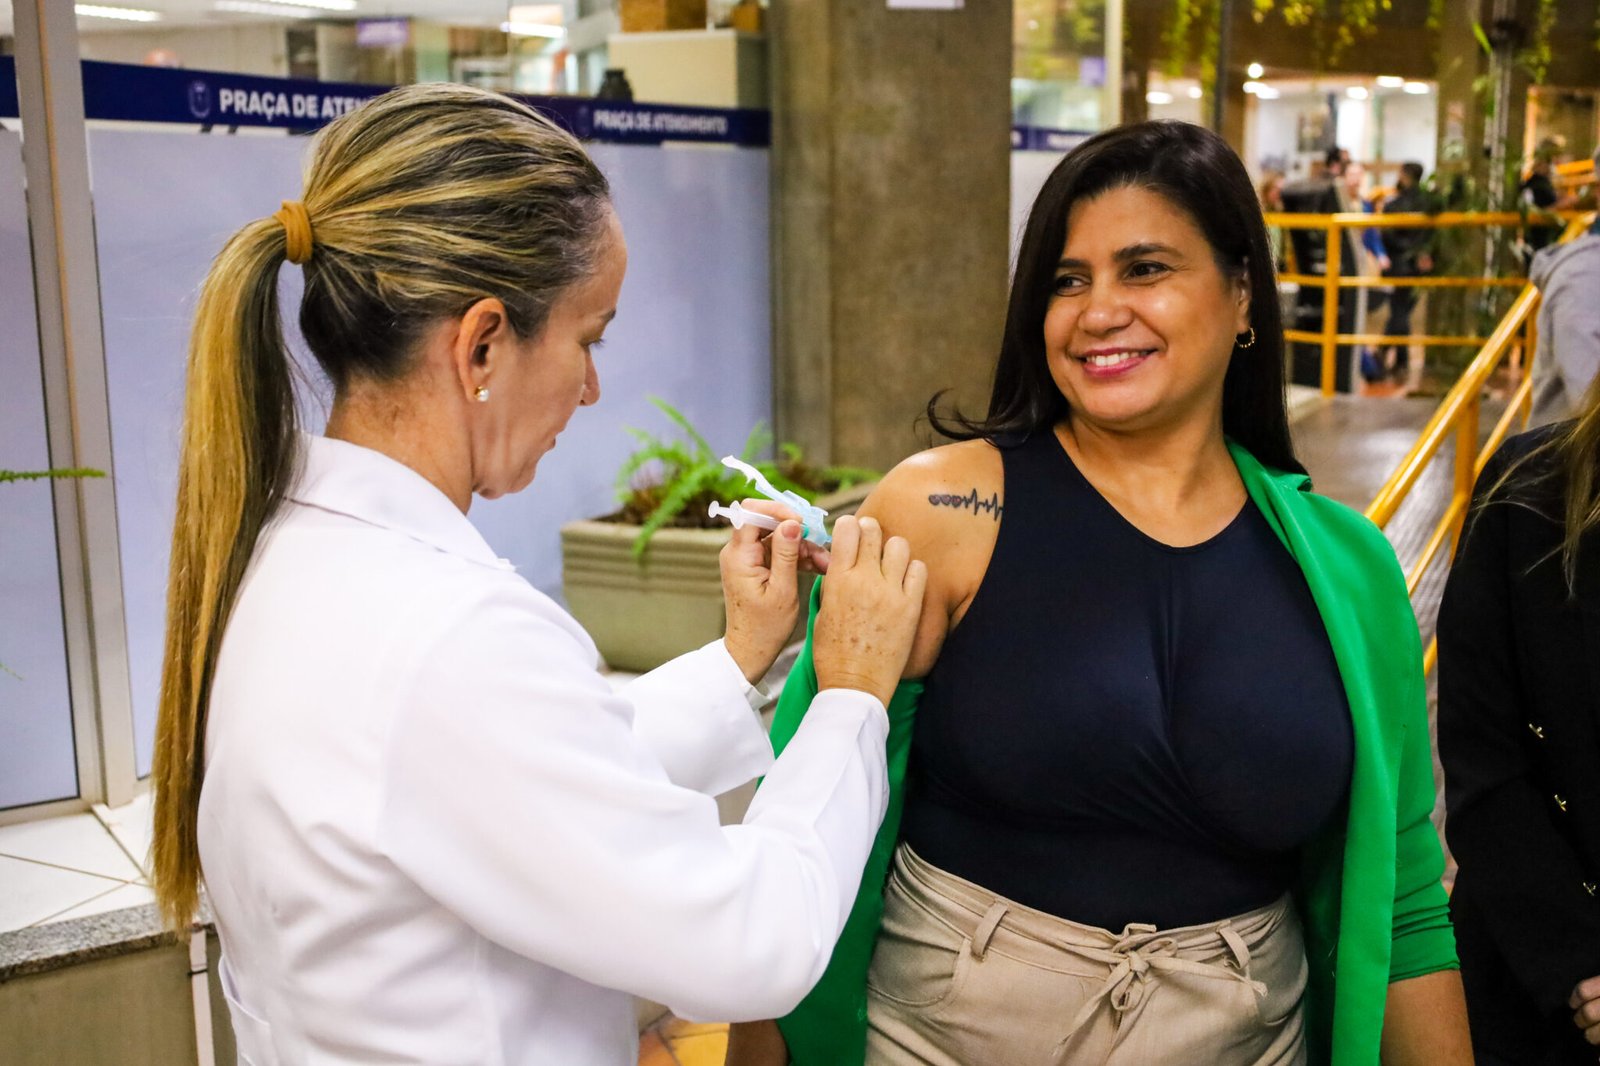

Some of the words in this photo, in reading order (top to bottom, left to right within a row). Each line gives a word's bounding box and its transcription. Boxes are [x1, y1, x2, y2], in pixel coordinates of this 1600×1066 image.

[219, 88, 290, 122] PRAÇA
[292, 94, 319, 118] DE
[593, 109, 634, 136] PRAÇA
